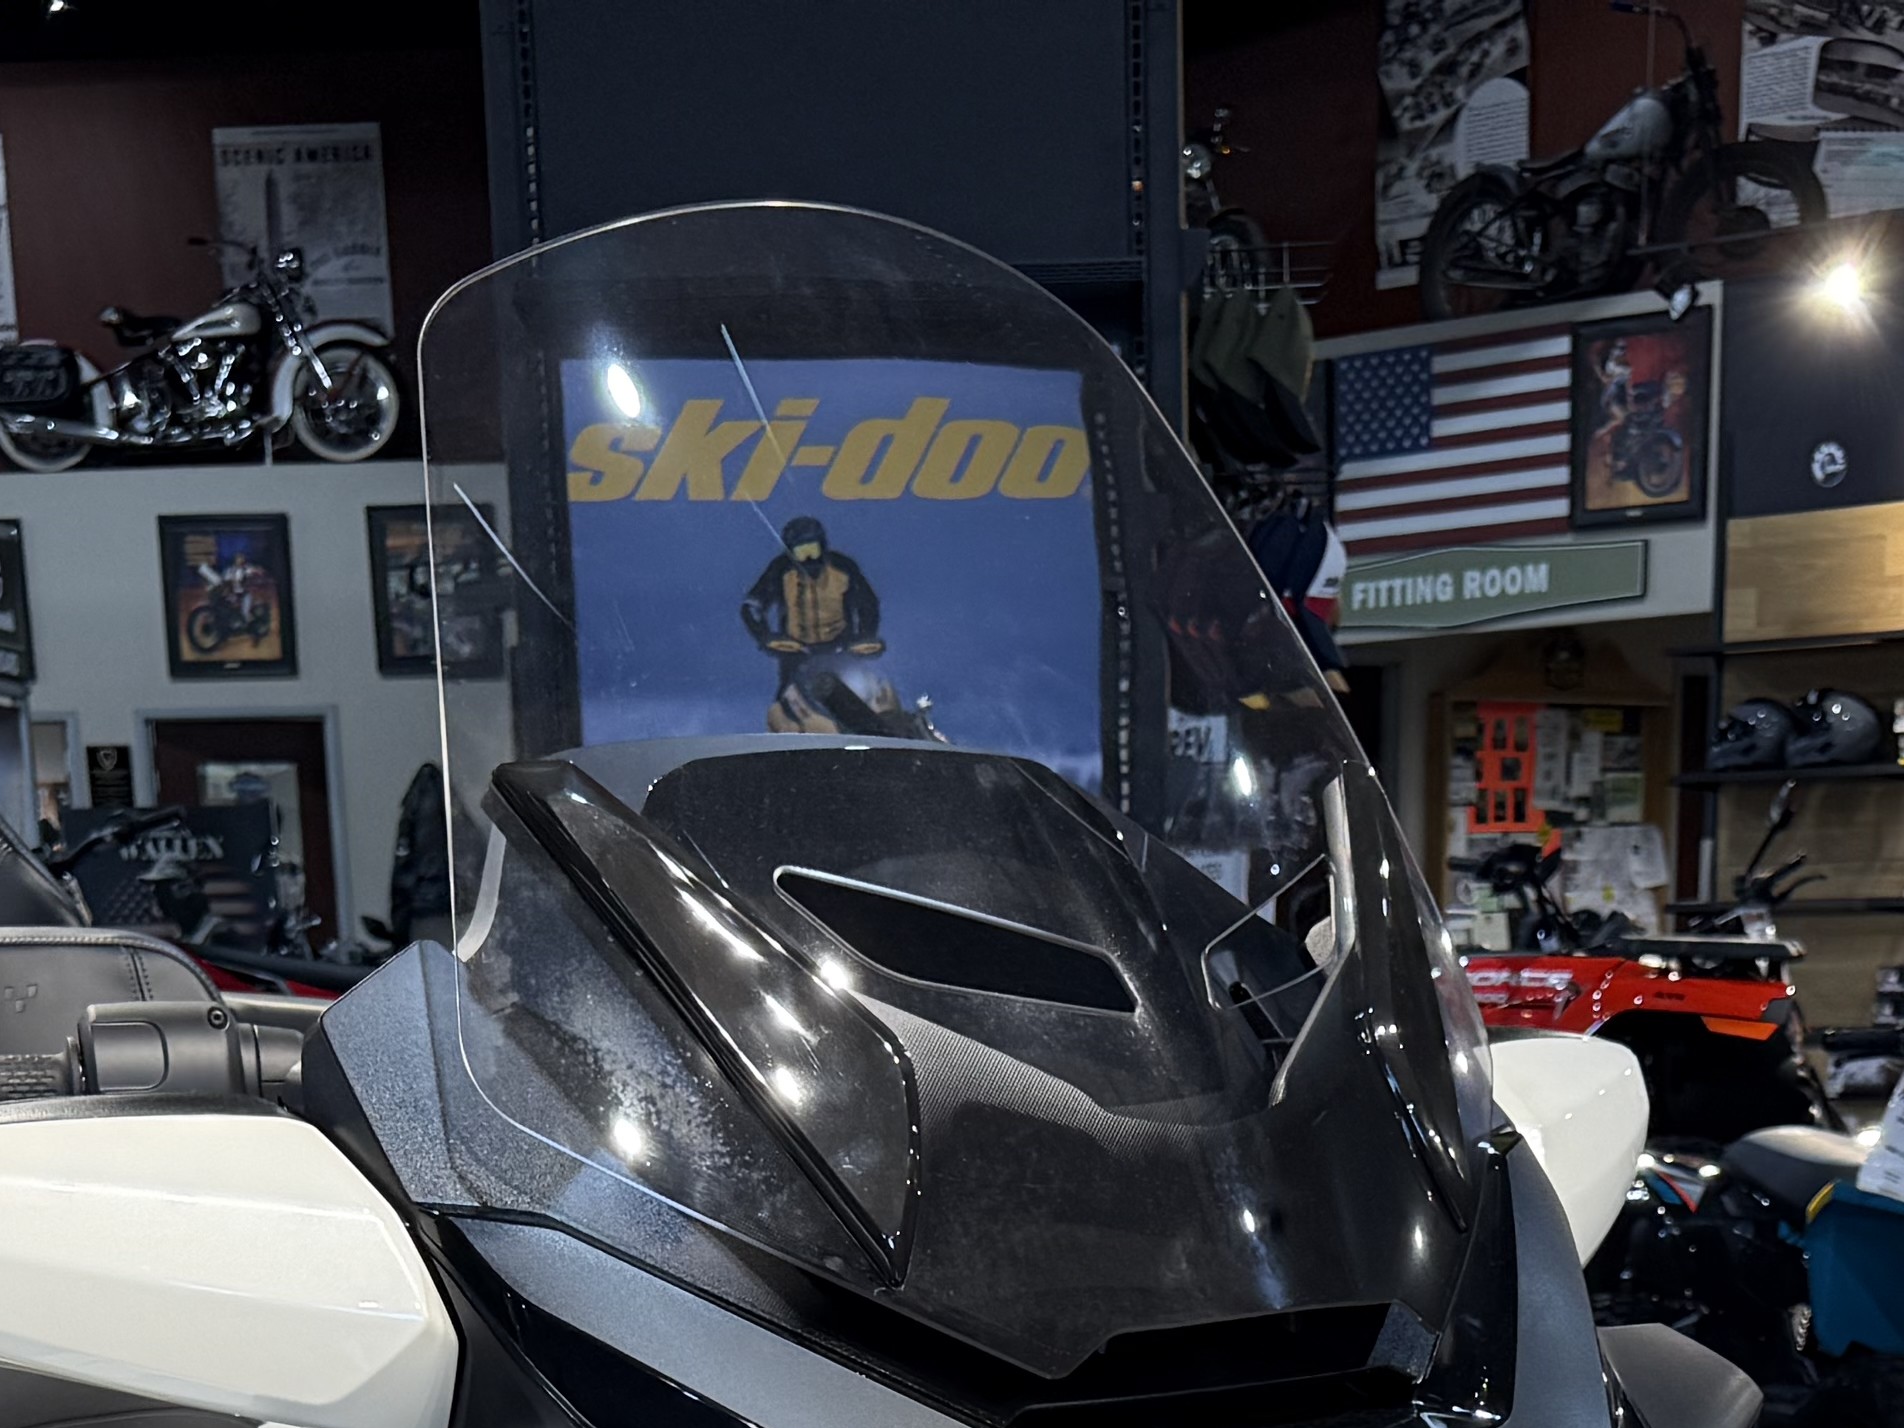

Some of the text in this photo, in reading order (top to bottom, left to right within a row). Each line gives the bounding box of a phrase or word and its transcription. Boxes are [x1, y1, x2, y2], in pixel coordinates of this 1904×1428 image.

[566, 396, 1091, 503] ski-doo
[1351, 562, 1550, 610] FITTING ROOM
